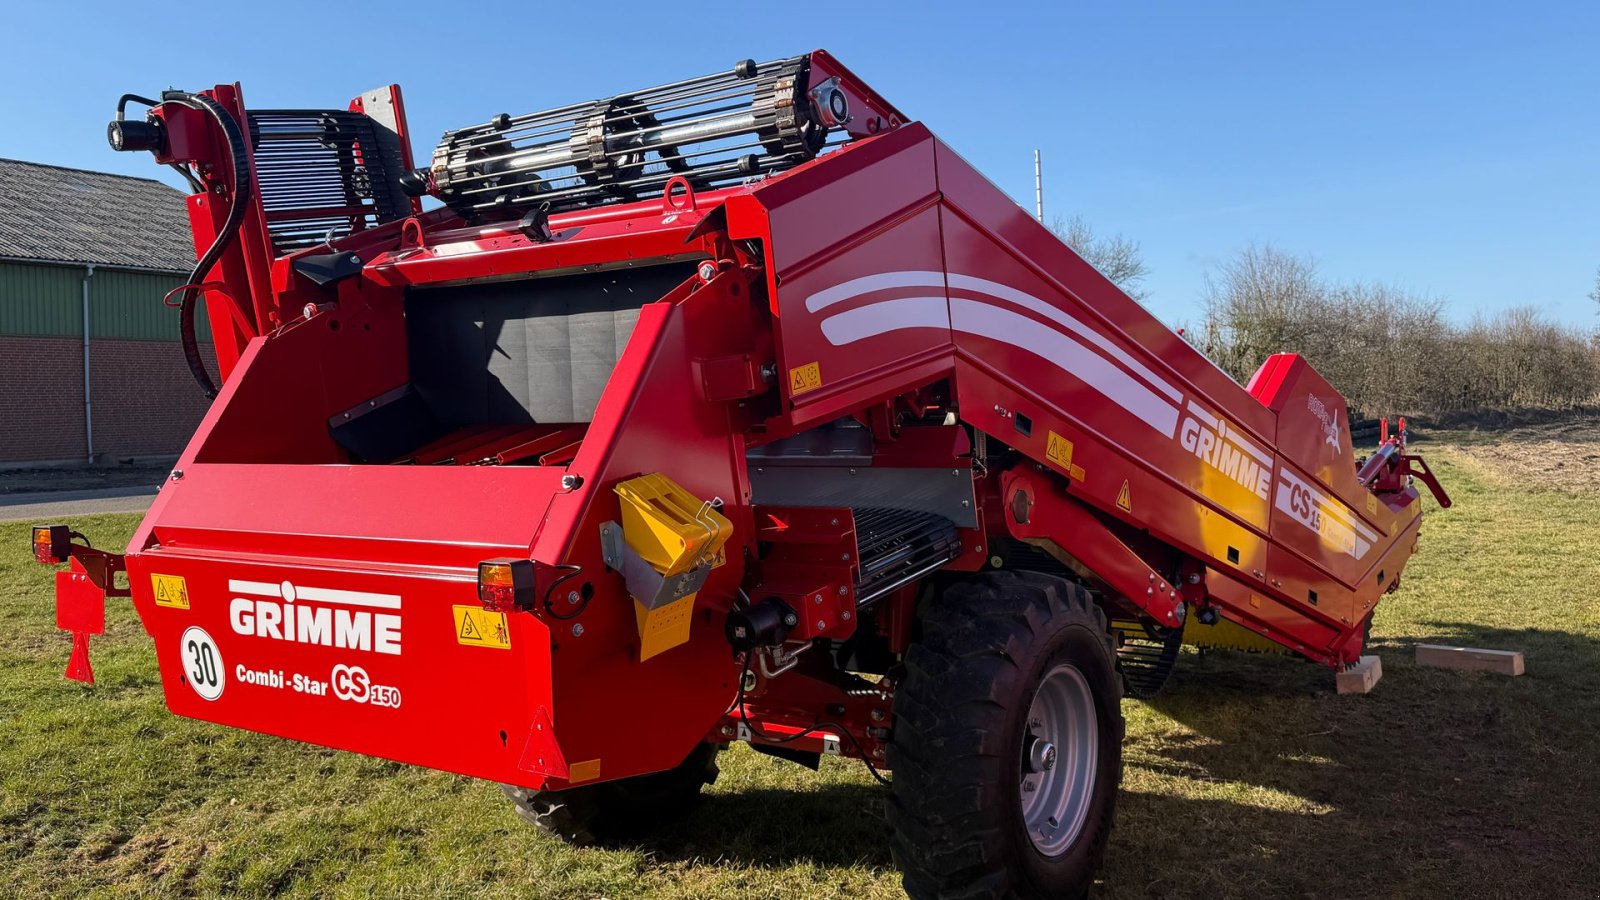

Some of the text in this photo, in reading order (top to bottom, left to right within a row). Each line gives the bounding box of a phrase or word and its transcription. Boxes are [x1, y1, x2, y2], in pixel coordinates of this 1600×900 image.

[1180, 417, 1272, 501] GRIMME
[229, 581, 401, 655] GRIMME
[187, 640, 217, 687] 30
[235, 664, 328, 696] Combi-Star
